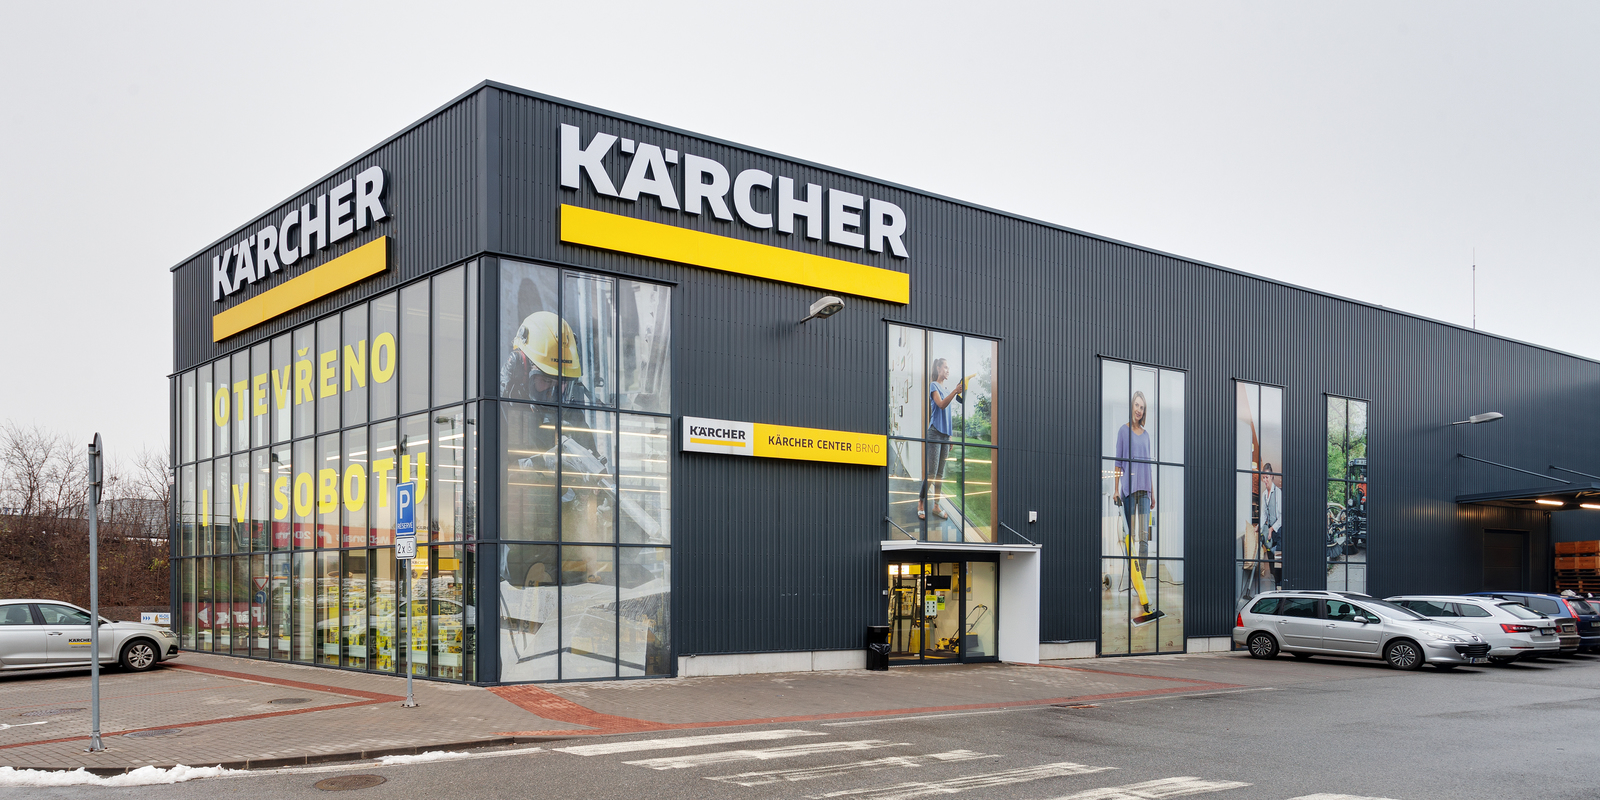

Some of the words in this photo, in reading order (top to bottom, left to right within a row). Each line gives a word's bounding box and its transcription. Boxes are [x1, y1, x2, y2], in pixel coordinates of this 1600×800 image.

[561, 123, 909, 258] KÄRCHER
[213, 165, 387, 302] KÄRCHER
[214, 332, 396, 427] OTEVŘENO
[690, 425, 746, 440] KÄRCHER
[768, 434, 814, 449] KÄRCHER
[817, 440, 852, 452] CENTER
[856, 443, 880, 454] BRNO
[202, 489, 208, 527] I
[232, 482, 249, 523] V
[274, 452, 427, 520] SOBOTU
[400, 490, 410, 519] P
